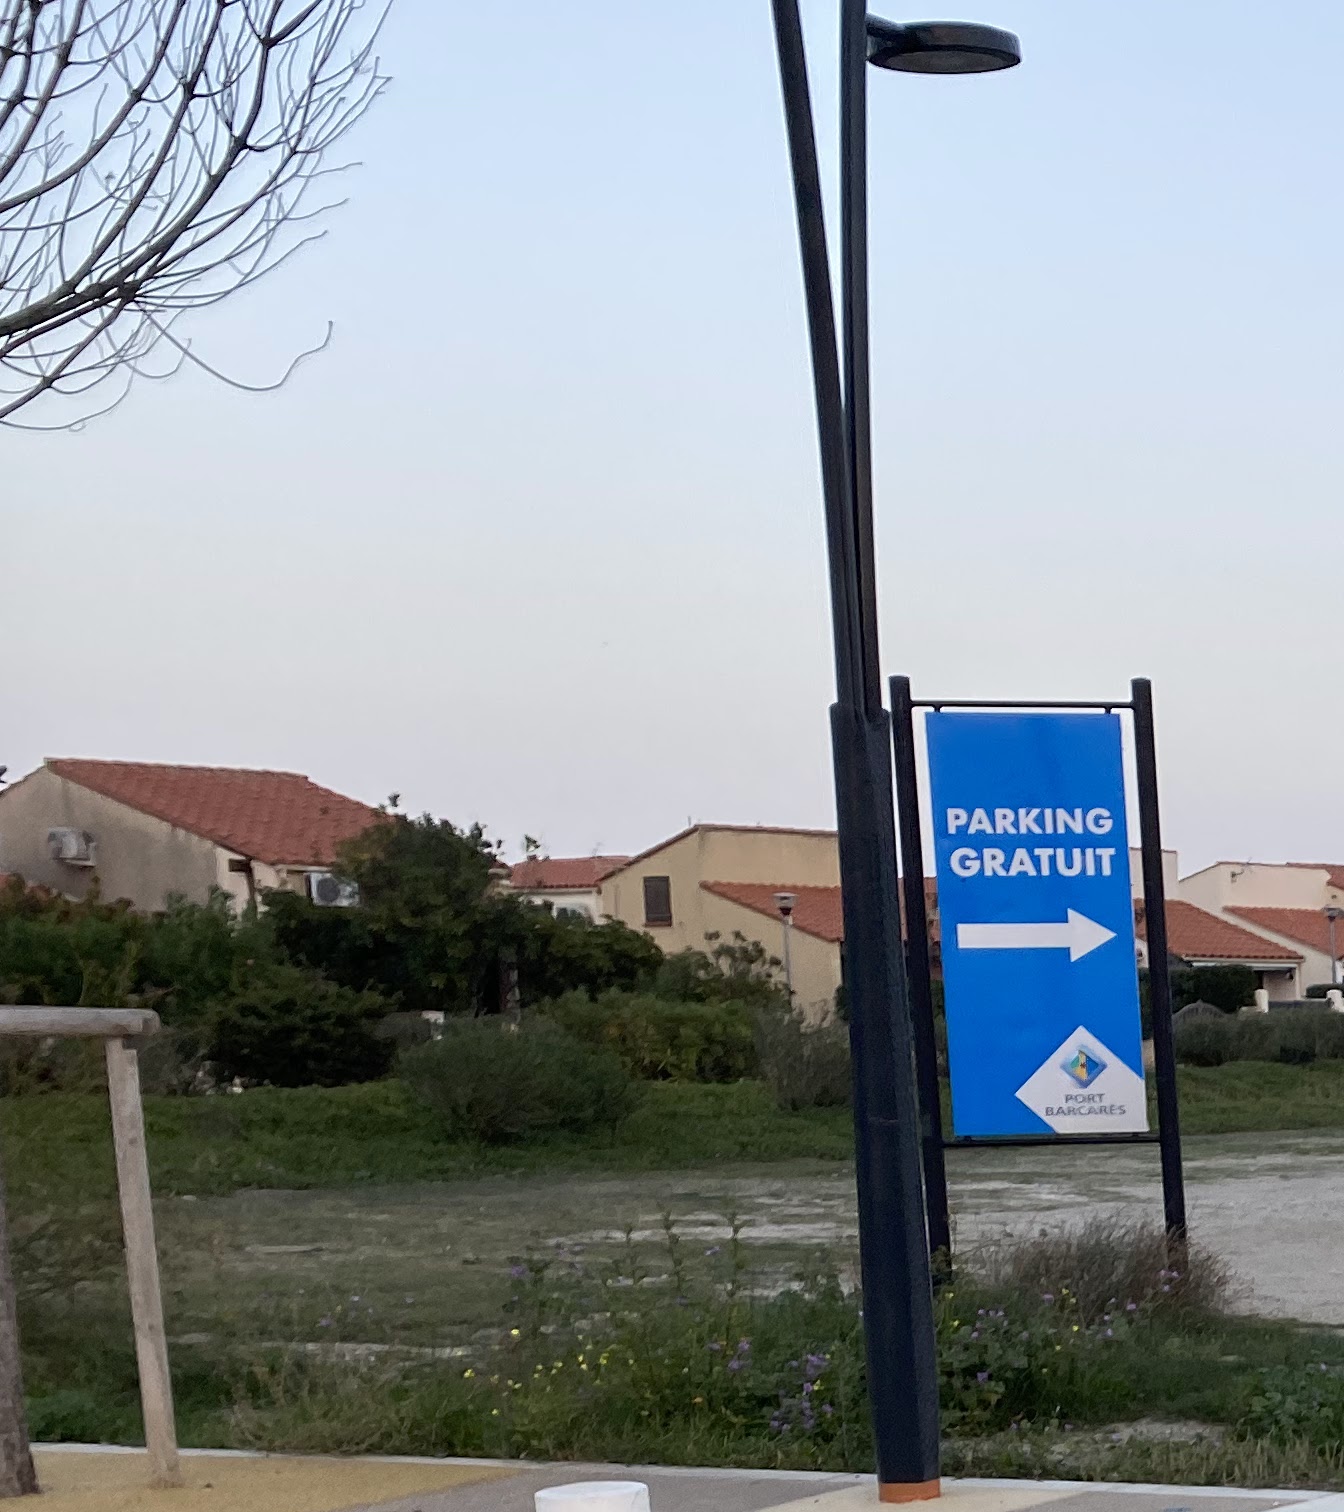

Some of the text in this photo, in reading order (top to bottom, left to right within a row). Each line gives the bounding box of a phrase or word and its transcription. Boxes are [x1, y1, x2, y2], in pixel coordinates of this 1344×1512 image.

[947, 807, 1113, 835] PARKING
[950, 847, 1116, 877] GRATUIT
[1065, 1093, 1106, 1103] PORT
